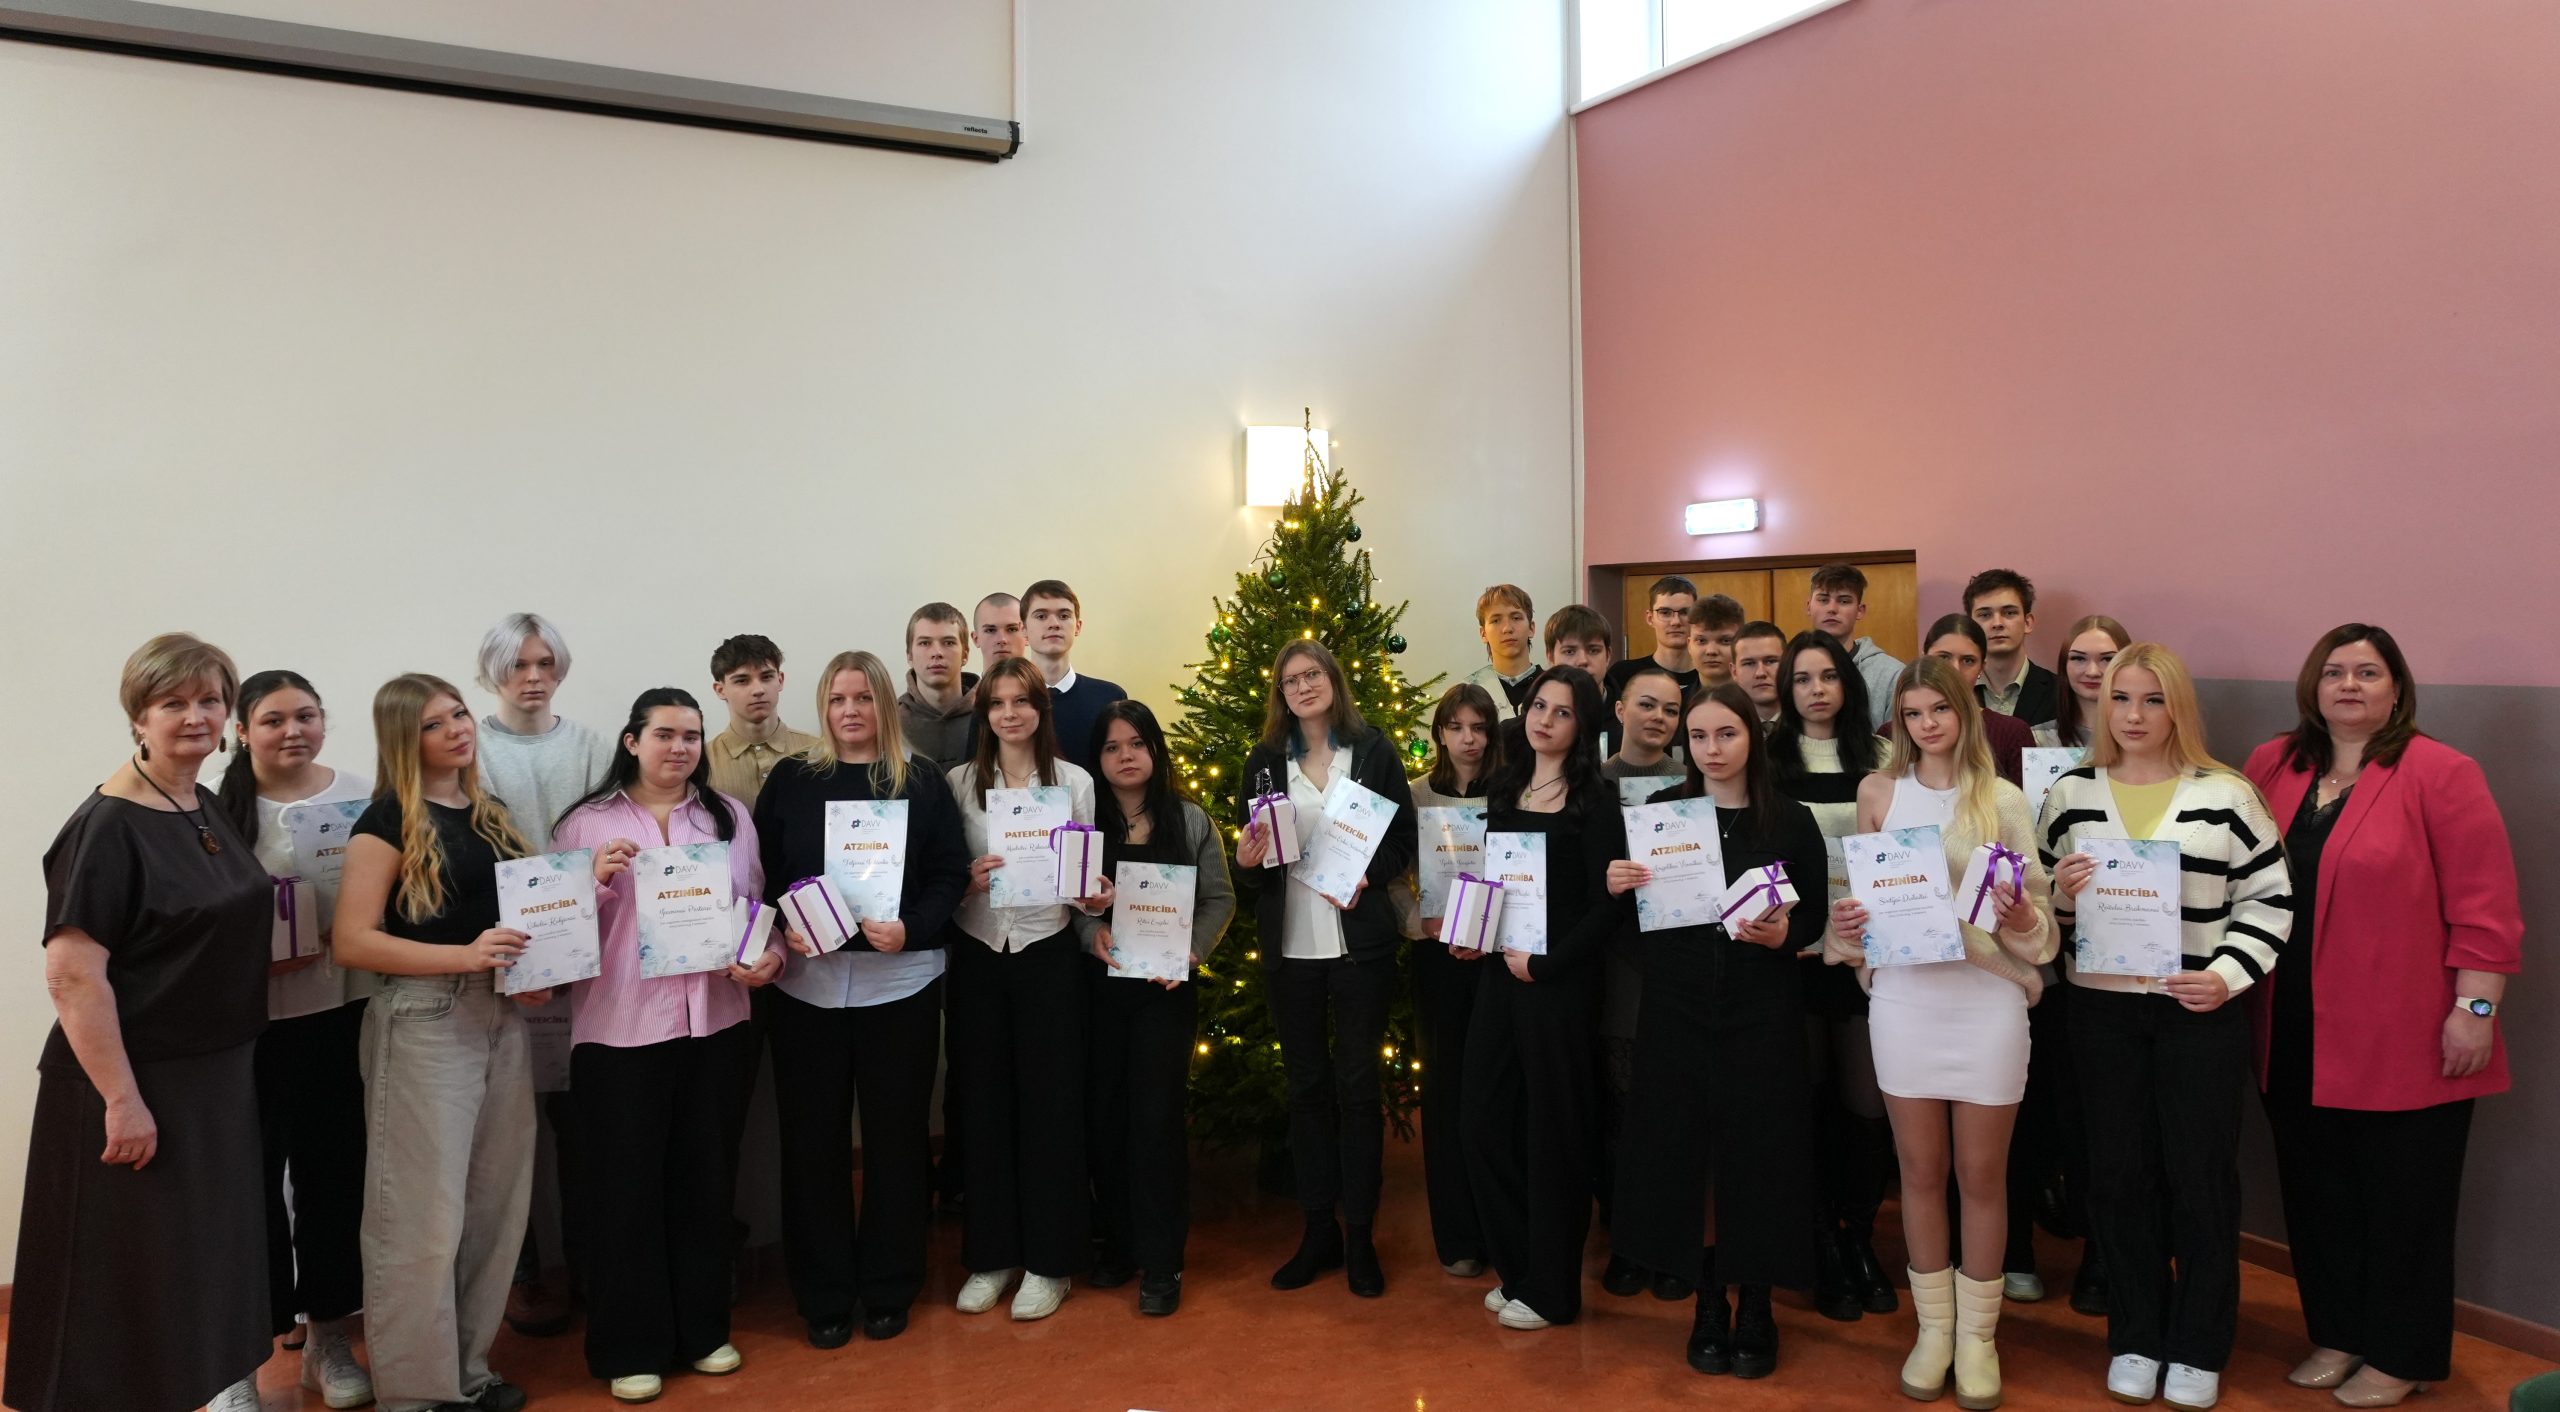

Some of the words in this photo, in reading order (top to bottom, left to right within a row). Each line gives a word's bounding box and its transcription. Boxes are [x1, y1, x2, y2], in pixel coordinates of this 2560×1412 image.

[963, 126, 988, 134] reflecta
[1665, 821, 1687, 830] DAVV
[1005, 829, 1049, 838] PATEICĪB
[1333, 820, 1368, 842] PATEICĪBA
[844, 841, 889, 851] ATZINĪBA
[1435, 843, 1479, 852] ATZINĪBA
[1650, 842, 1701, 857] ATZINĪBA
[1888, 850, 1911, 861] DAVV
[675, 865, 698, 874] DAVV
[2120, 860, 2145, 869] DAVV
[540, 874, 562, 885] DAVV
[1499, 873, 1534, 882] ATZINĪBA
[1872, 874, 1928, 889] ATZINĪBA
[657, 886, 711, 900] ATZINĪBA
[2096, 887, 2159, 898] PATEICĪBA
[520, 899, 578, 915] PATEICĪBA
[1129, 904, 1177, 914] PATEICĪBA
